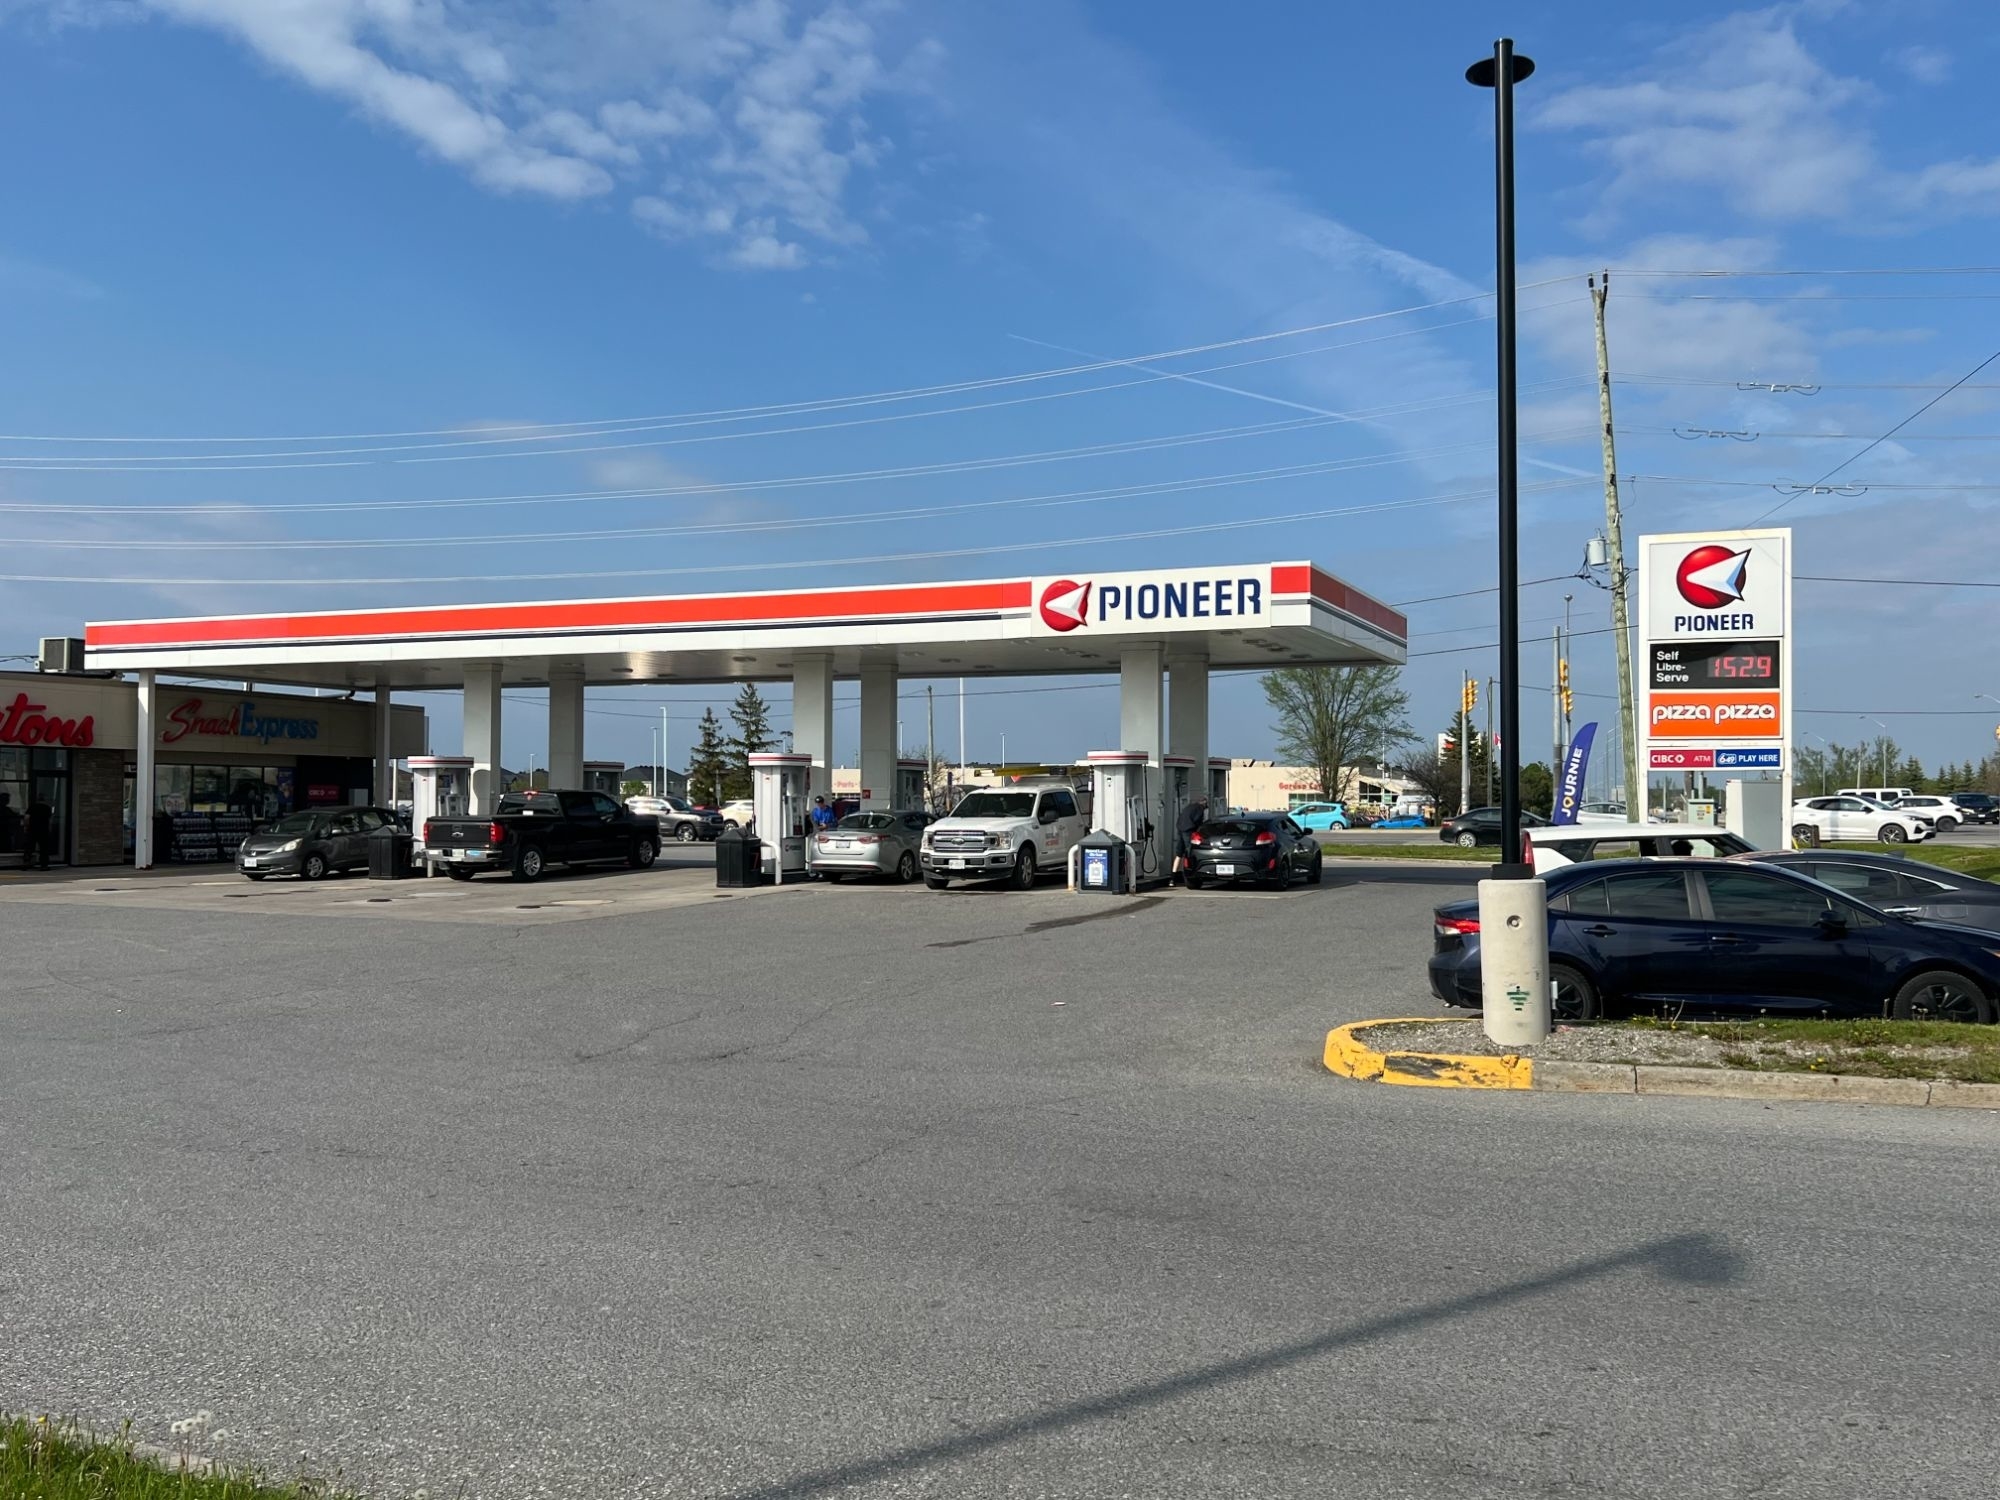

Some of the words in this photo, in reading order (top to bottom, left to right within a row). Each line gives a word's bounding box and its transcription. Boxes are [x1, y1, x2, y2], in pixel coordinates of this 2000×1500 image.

[1099, 578, 1262, 622] PIONEER
[1674, 613, 1754, 632] PIONEER
[1656, 651, 1679, 661] Self
[1656, 663, 1686, 671] Libre-
[1656, 672, 1689, 682] Serve
[0, 692, 94, 747] tons
[160, 698, 240, 743] Snack
[240, 702, 319, 744] Express
[1652, 704, 1711, 725] pizza
[1715, 703, 1776, 725] pizza
[1651, 754, 1675, 763] CIBC
[1759, 754, 1778, 762] HERE
[1561, 747, 1583, 818] JOURNIE
